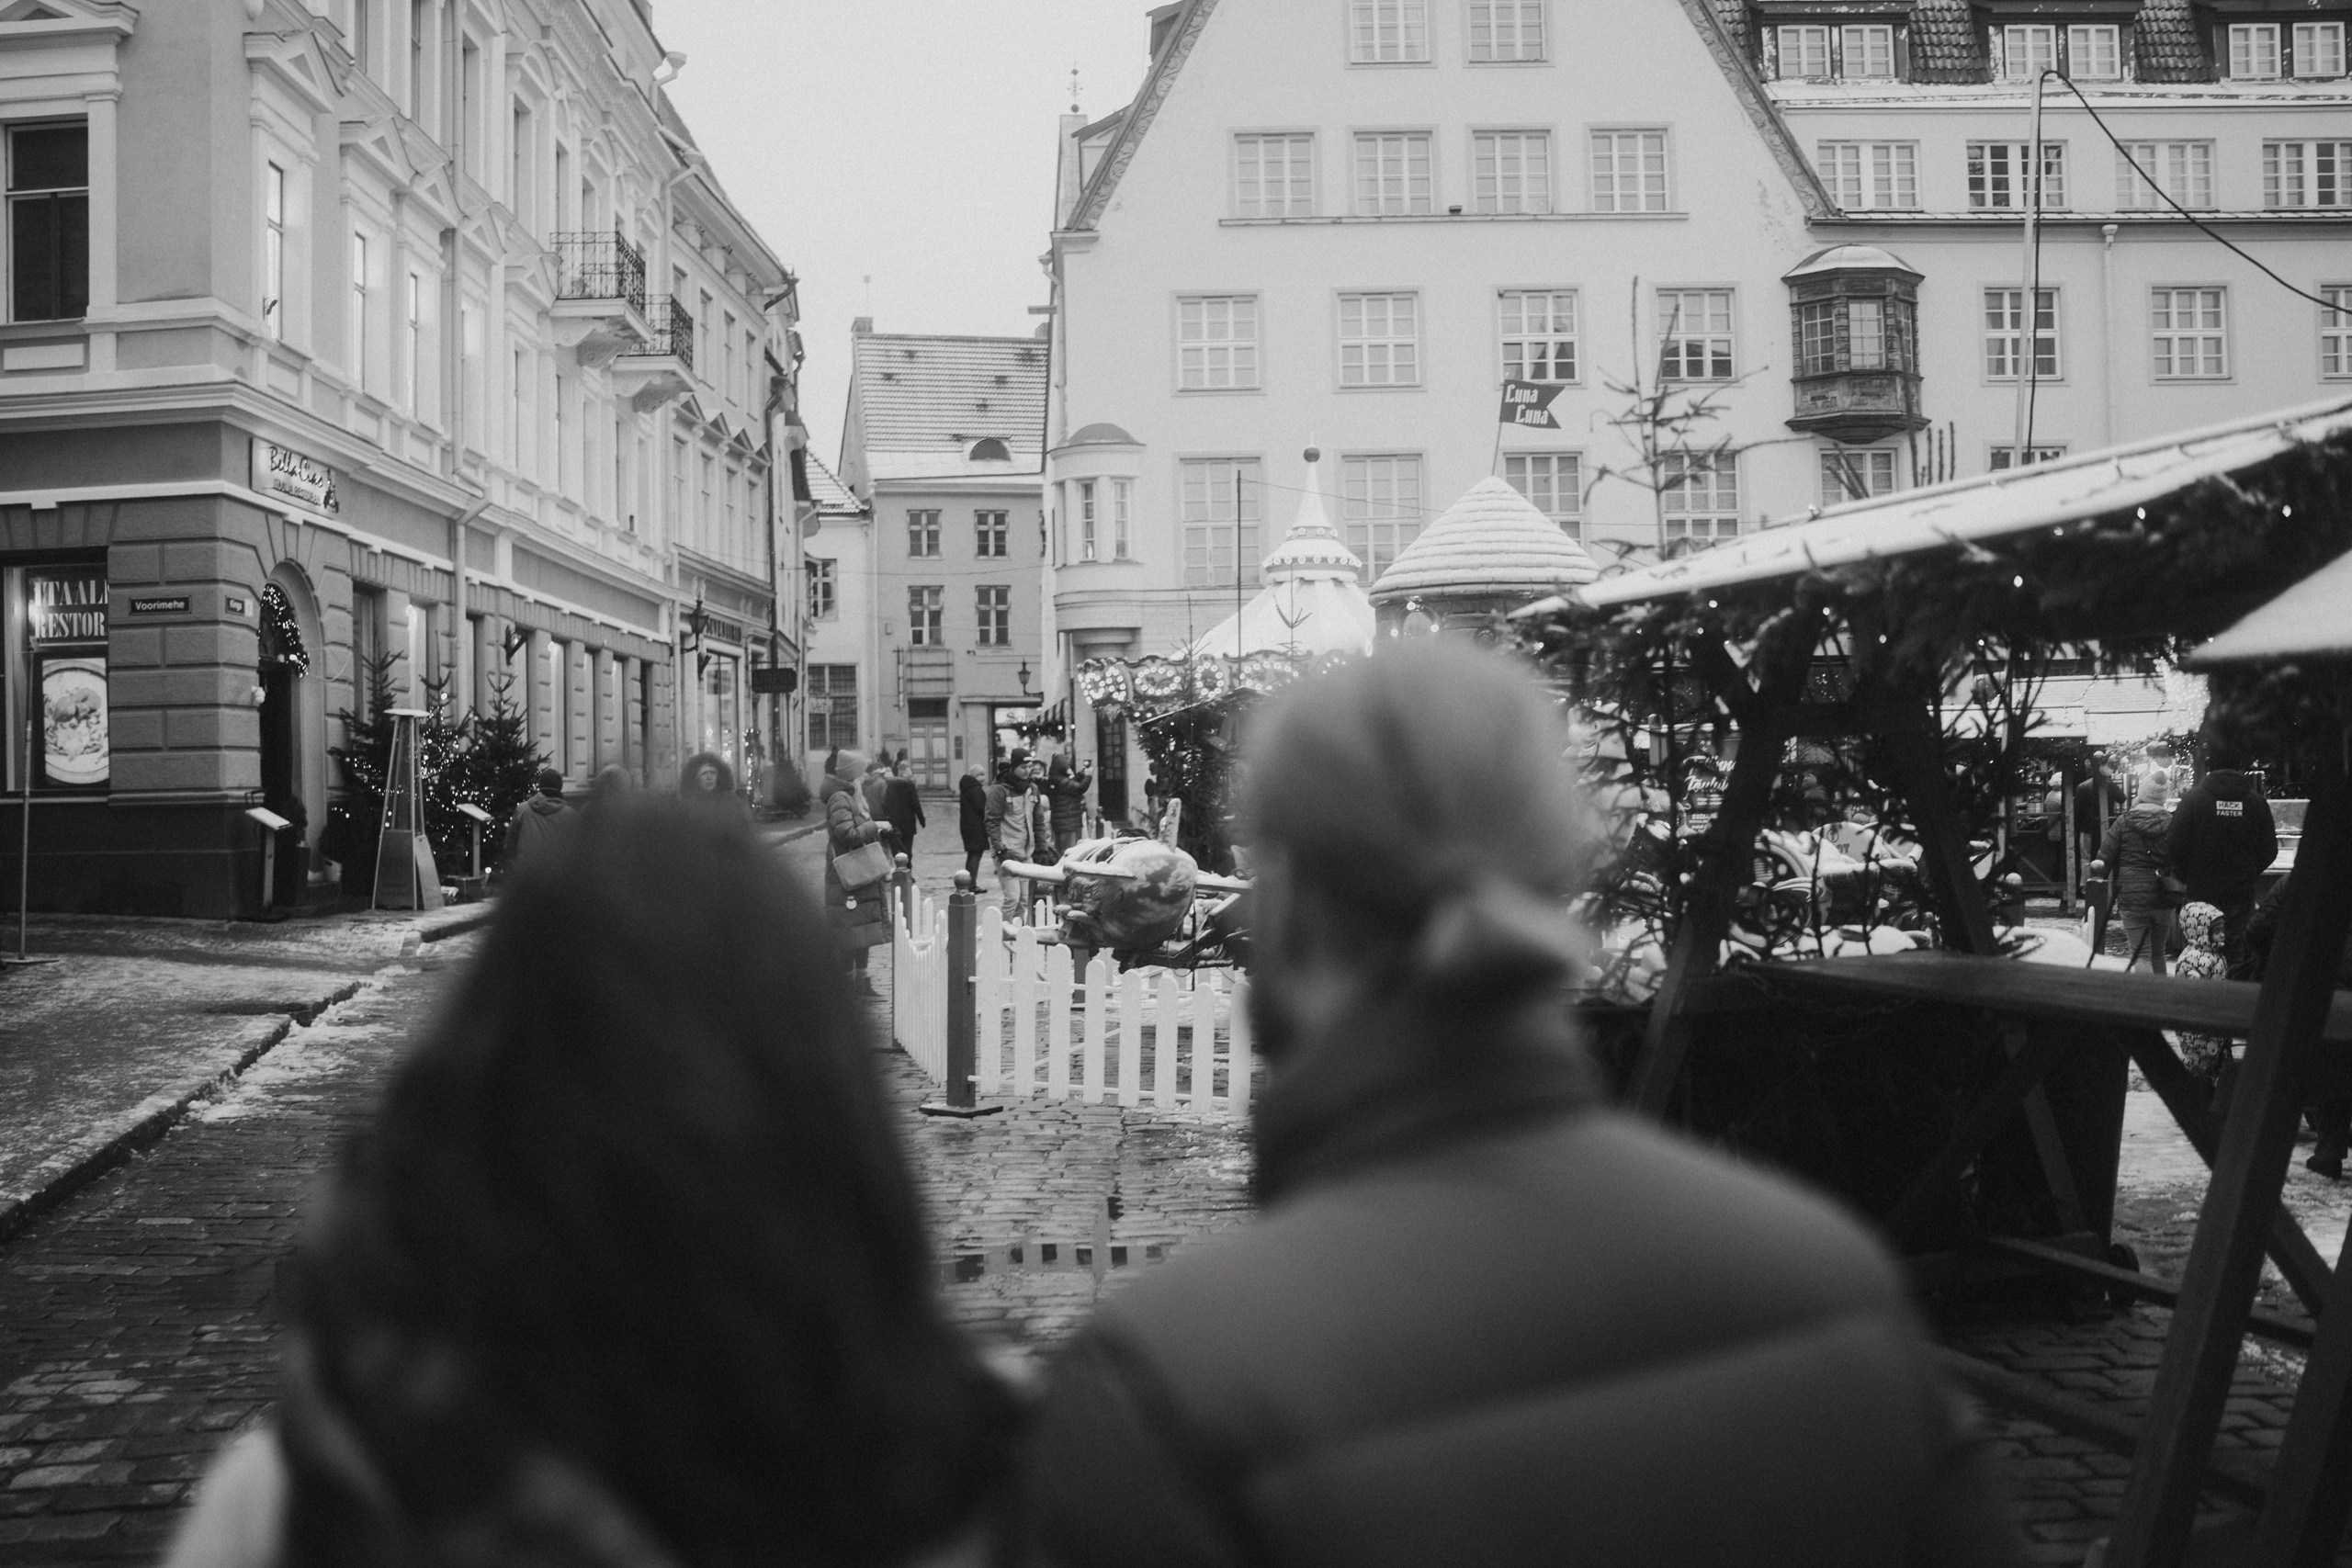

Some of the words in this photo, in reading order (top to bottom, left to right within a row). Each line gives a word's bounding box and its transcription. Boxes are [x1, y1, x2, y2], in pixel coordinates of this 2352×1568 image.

[1505, 384, 1539, 403] Luna
[1515, 404, 1549, 424] Luna
[269, 446, 297, 477] Bella
[300, 456, 322, 488] Ciao
[135, 600, 185, 611] Voorimehe
[35, 613, 107, 638] RESTOR
